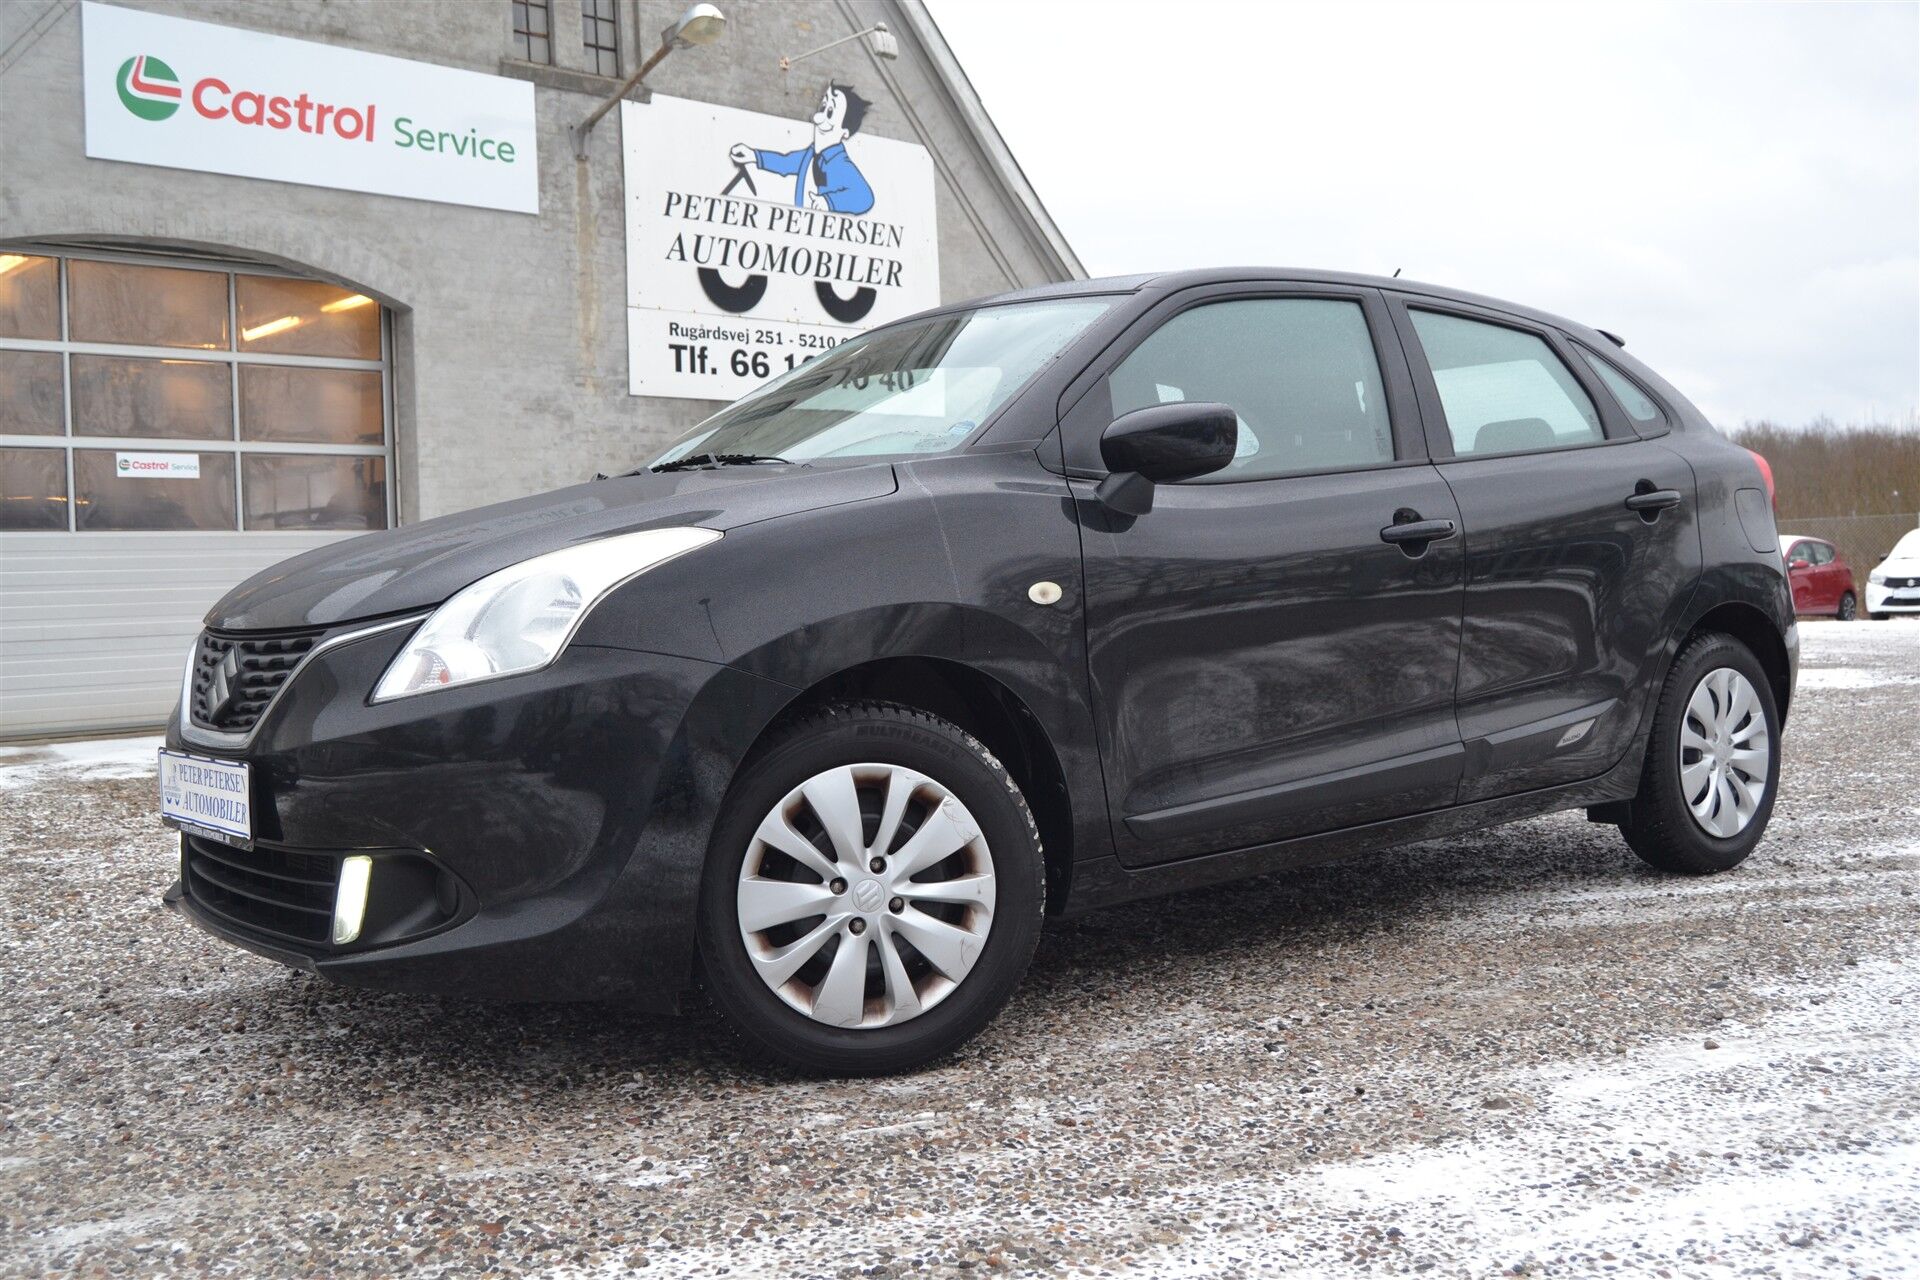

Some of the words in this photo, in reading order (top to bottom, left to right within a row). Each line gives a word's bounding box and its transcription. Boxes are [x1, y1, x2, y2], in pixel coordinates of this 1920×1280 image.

[191, 77, 376, 142] Castrol
[394, 117, 516, 163] Service
[664, 191, 758, 229] PETER
[767, 205, 904, 249] PETERSEN
[665, 232, 903, 288] AUTOMOBILER
[669, 322, 750, 345] Rugårdsvej
[755, 330, 783, 346] 251
[798, 334, 836, 349] 5210
[668, 344, 718, 375] Tlf.
[730, 349, 770, 378] 66
[784, 354, 815, 373] 1
[879, 370, 914, 392] 40
[132, 461, 169, 470] Castrol
[171, 463, 197, 471] Service
[179, 764, 204, 786] PETER
[204, 768, 246, 793] PETERSEN
[182, 790, 247, 825] AUTOMOBILER
